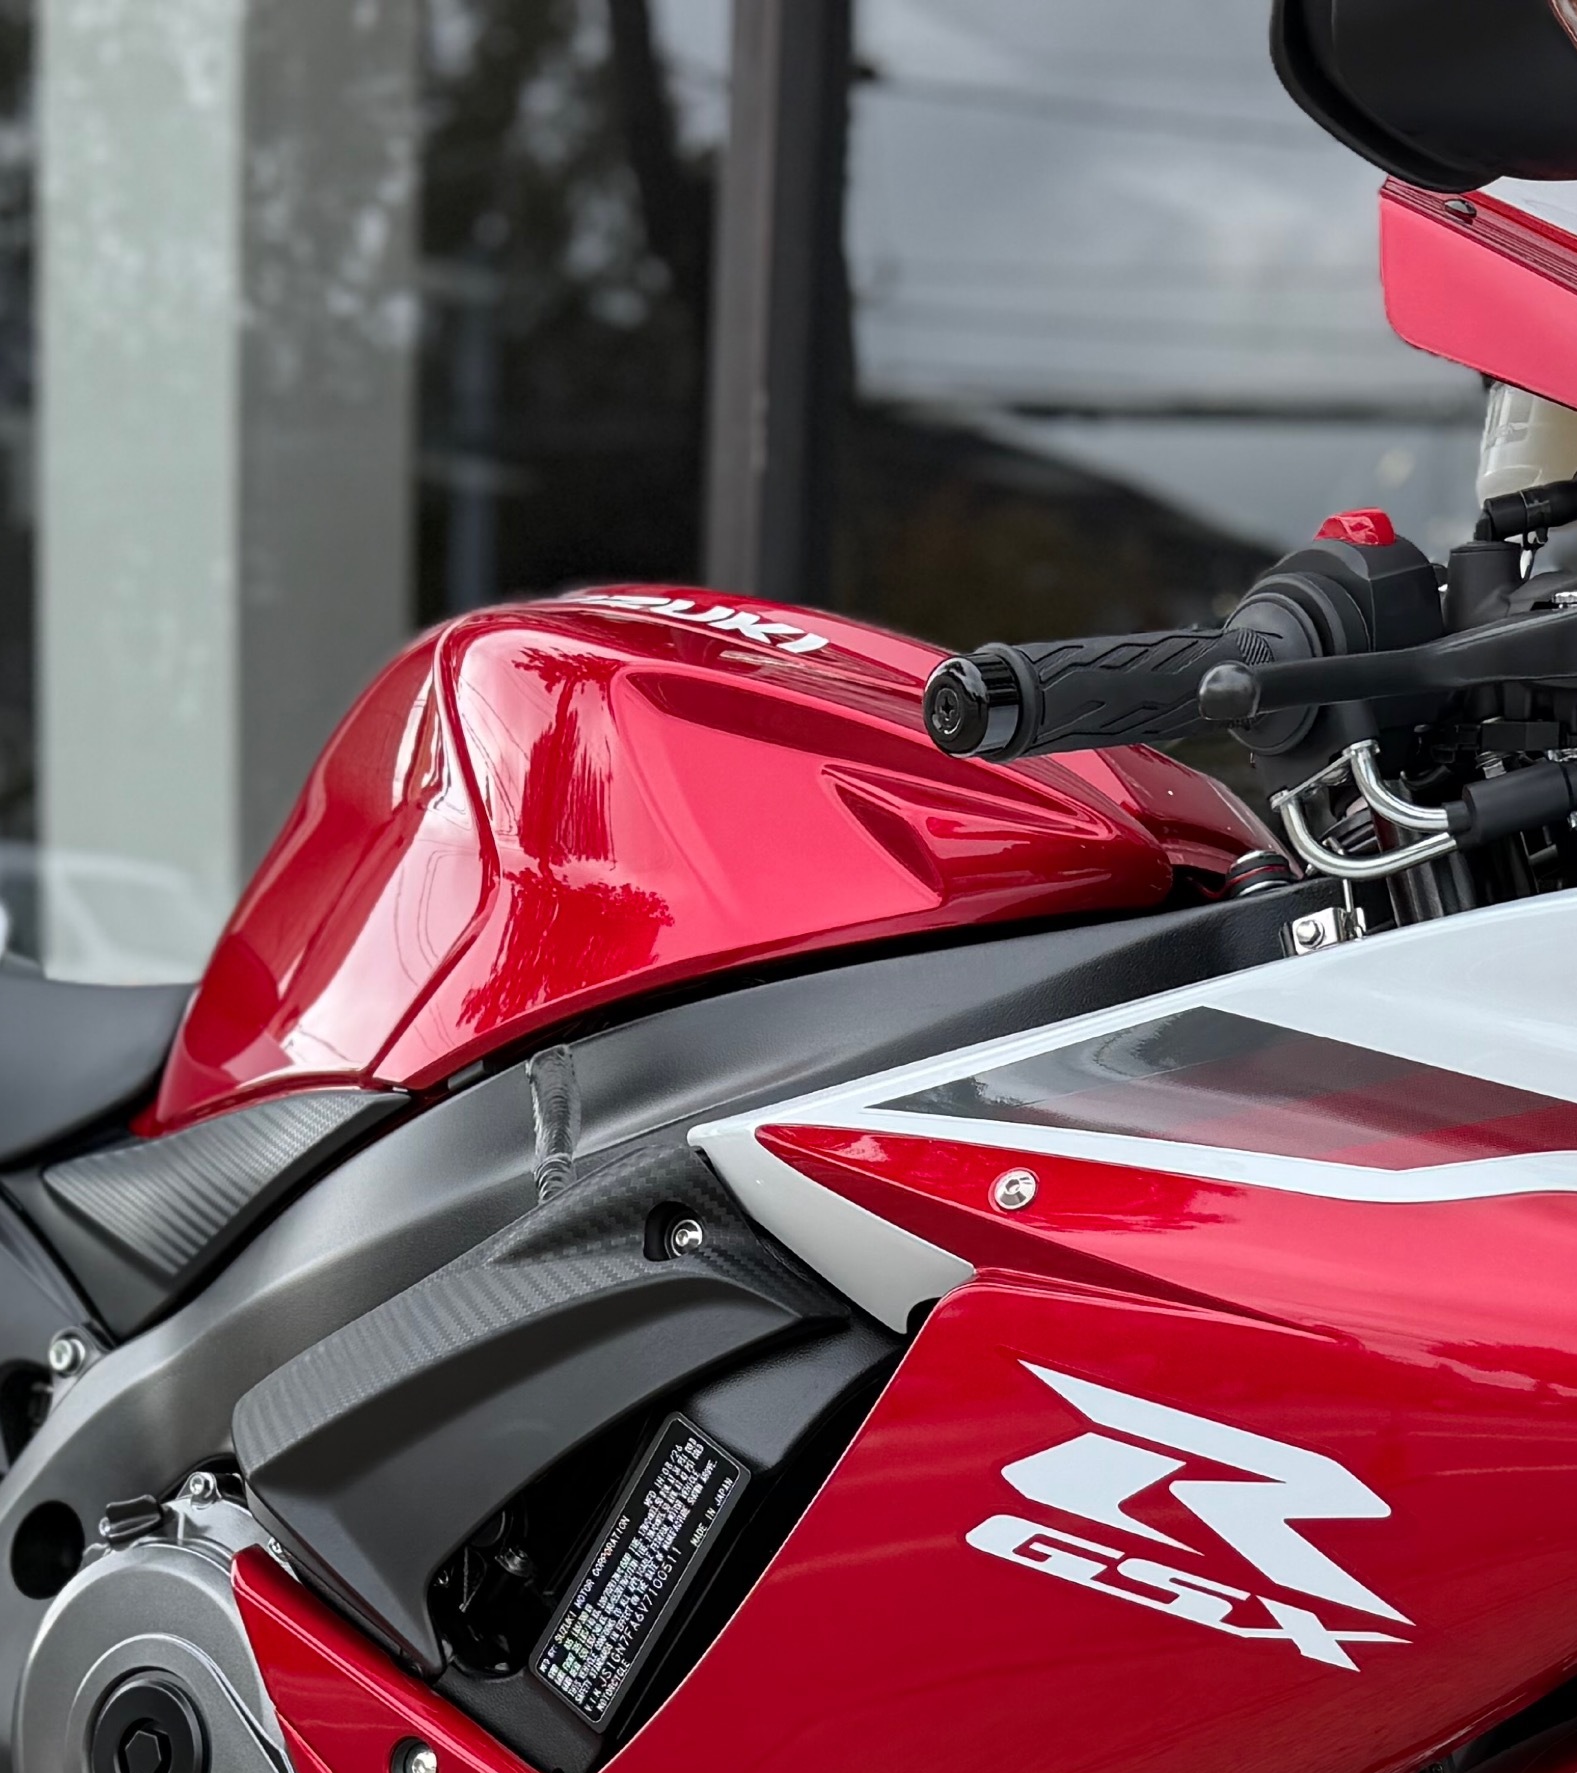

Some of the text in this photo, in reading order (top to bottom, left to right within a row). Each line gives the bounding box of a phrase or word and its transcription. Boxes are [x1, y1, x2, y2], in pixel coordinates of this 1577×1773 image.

[553, 1609, 577, 1645] SUZUKI
[573, 1576, 595, 1609] MOTOR
[590, 1514, 631, 1578] CORPORATION
[595, 1656, 631, 1713] MOTORCYCLE
[689, 1521, 708, 1547] MADE
[704, 1506, 716, 1520] IN
[711, 1475, 734, 1507] JAPAN
[966, 1515, 1414, 1672] GSX
